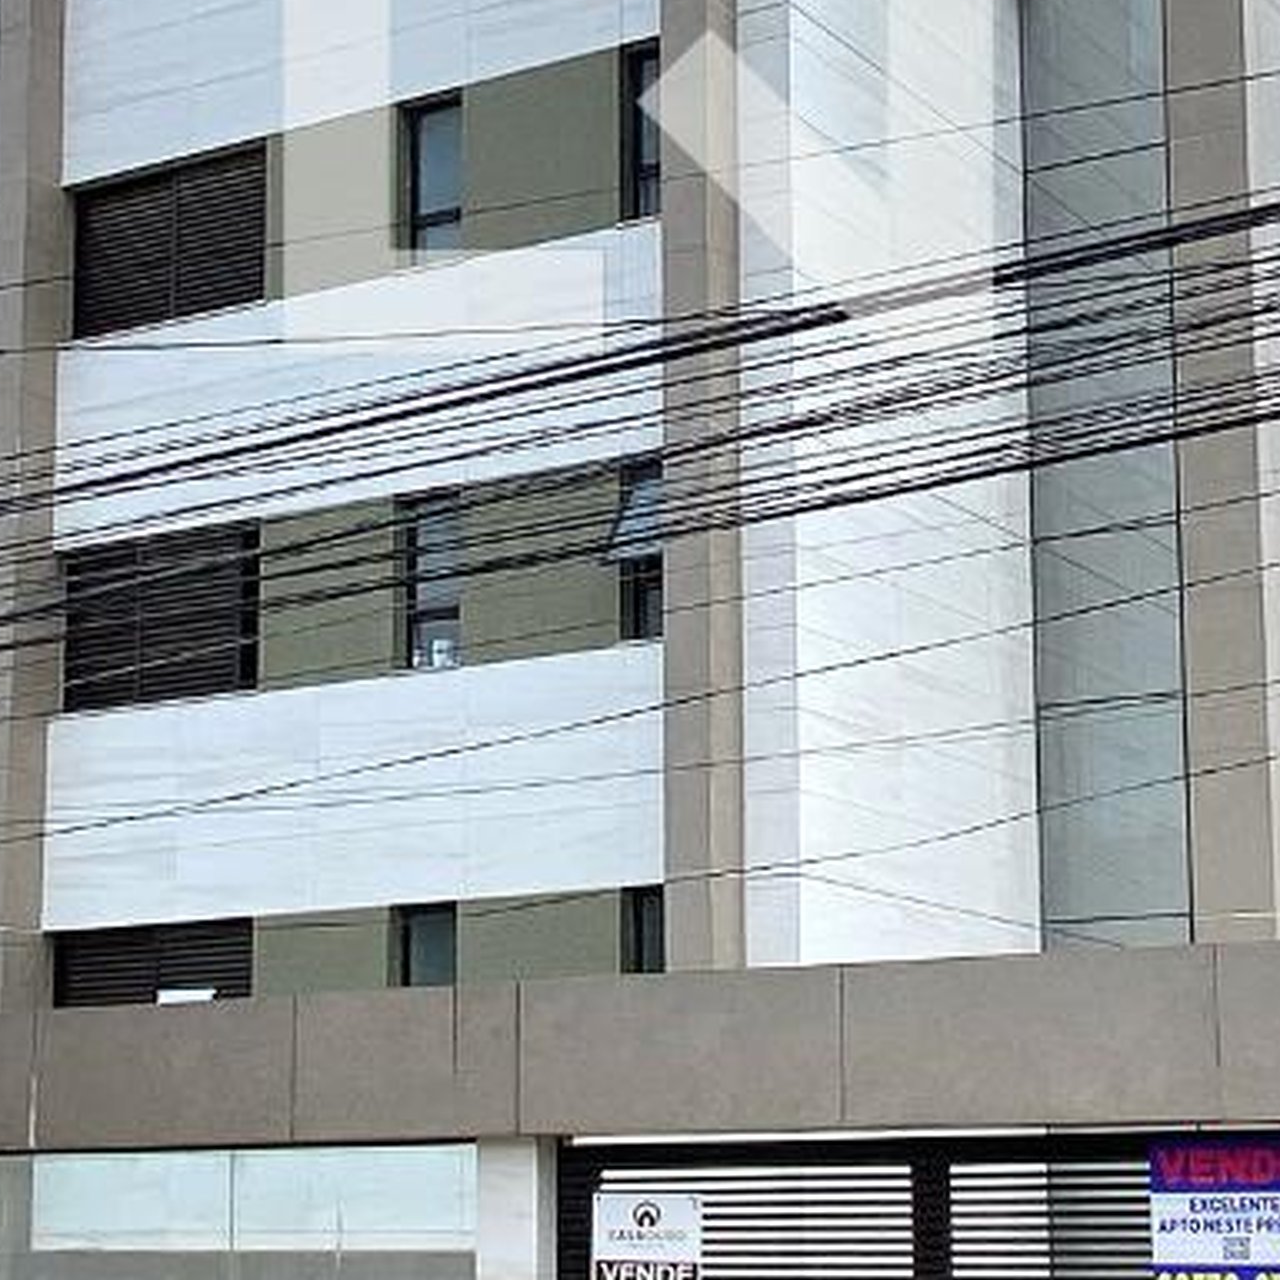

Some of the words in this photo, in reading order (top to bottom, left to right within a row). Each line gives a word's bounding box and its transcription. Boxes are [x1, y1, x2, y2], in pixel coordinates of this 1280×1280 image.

[1188, 1196, 1280, 1214] EXCELENTE
[1157, 1217, 1201, 1235] APTO
[1203, 1217, 1253, 1235] NESTE
[600, 1262, 695, 1280] VENDE
